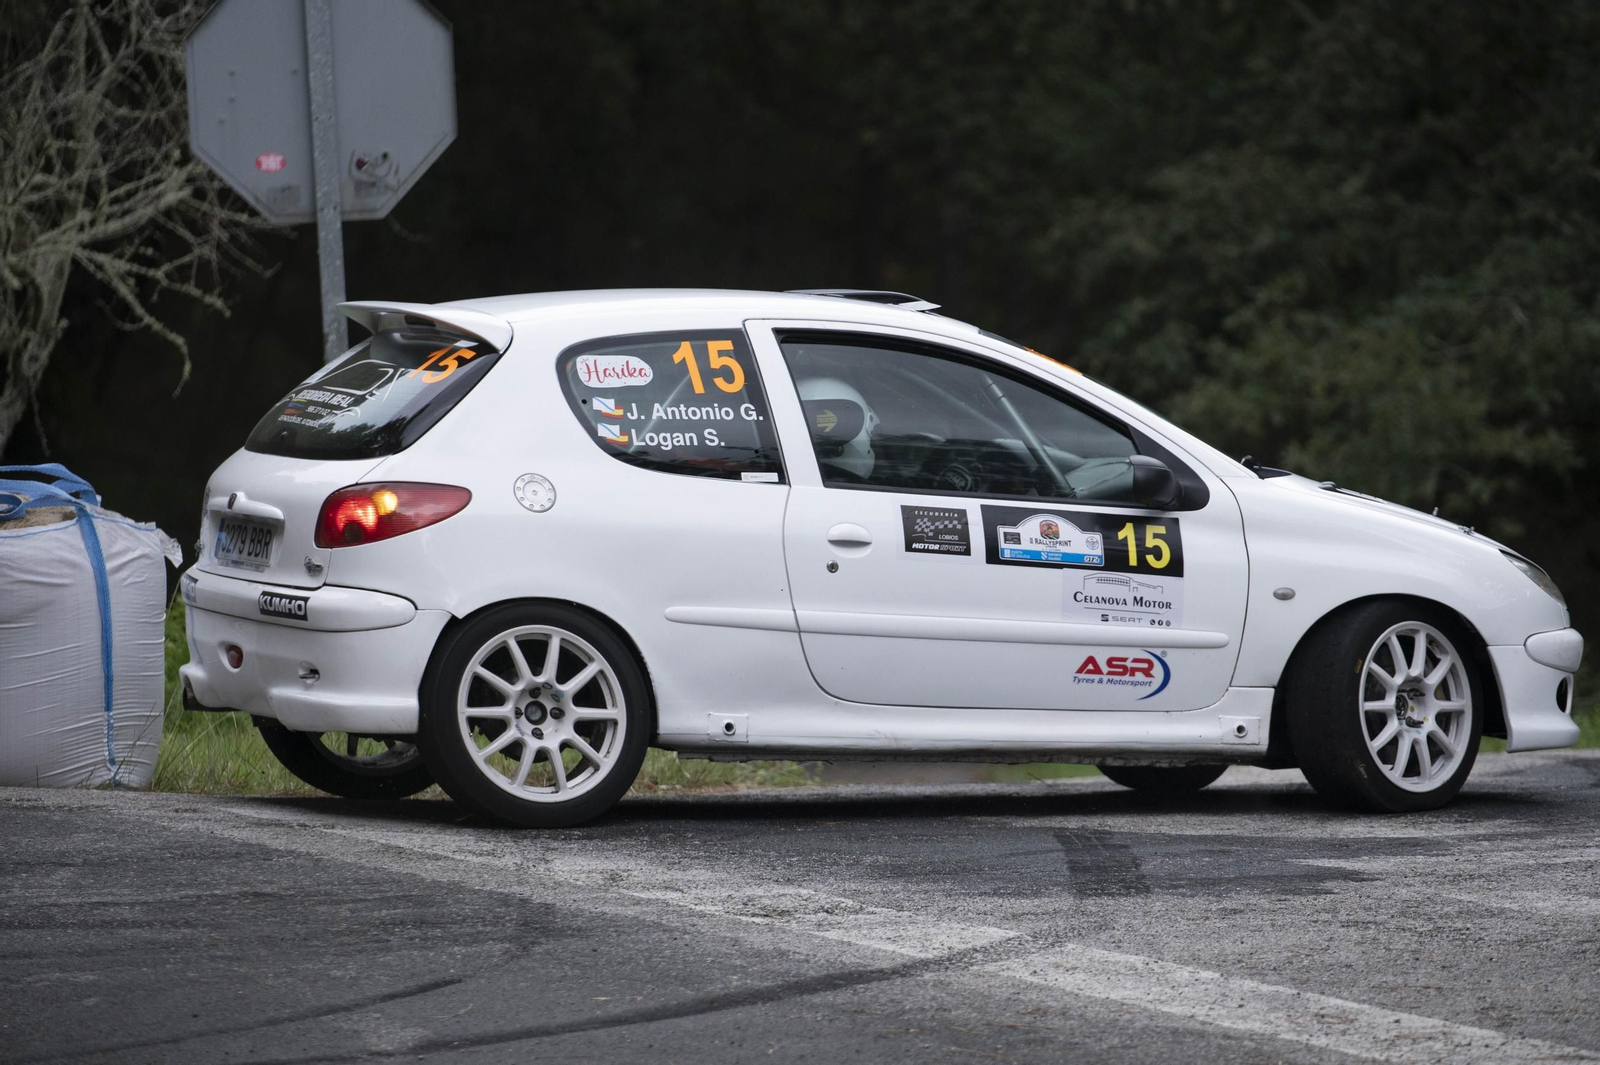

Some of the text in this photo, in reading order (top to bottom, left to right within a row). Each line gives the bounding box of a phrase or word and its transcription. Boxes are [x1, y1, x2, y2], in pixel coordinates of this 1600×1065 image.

[408, 347, 477, 384] 15
[583, 359, 650, 383] Harika
[672, 340, 745, 394] 15
[627, 403, 764, 421] J. Antonio G.
[631, 429, 725, 450] Logan S.
[915, 510, 958, 518] ESCUDERÍA
[247, 526, 272, 559] BBR
[1034, 538, 1071, 547] RALLYSPRINT
[1117, 522, 1171, 569] 15
[259, 594, 305, 616] KUMHO
[1073, 591, 1172, 610] CELANOVA MOTOR
[1111, 615, 1143, 623] SEAT
[1075, 655, 1155, 678] ASR
[1073, 676, 1095, 684] Tyres
[1105, 678, 1152, 687] Motorsport
